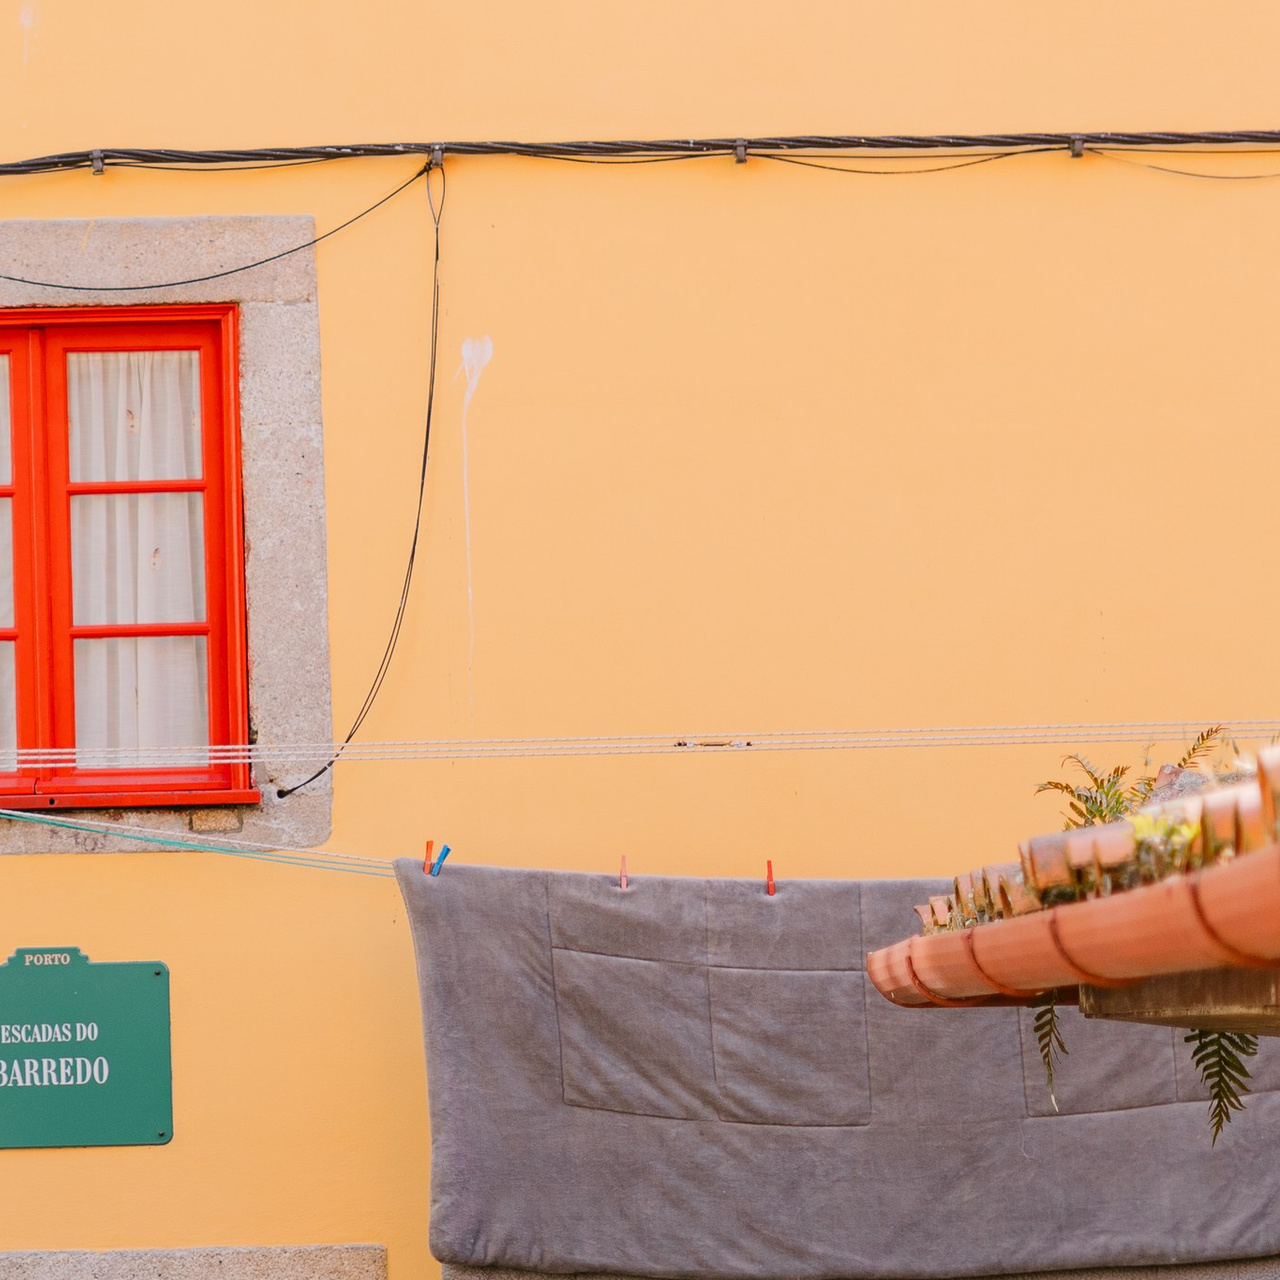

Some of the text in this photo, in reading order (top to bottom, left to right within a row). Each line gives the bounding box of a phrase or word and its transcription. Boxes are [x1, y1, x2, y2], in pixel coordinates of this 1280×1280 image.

[24, 953, 70, 966] PORTO
[1, 1022, 98, 1043] ESCADAS DO
